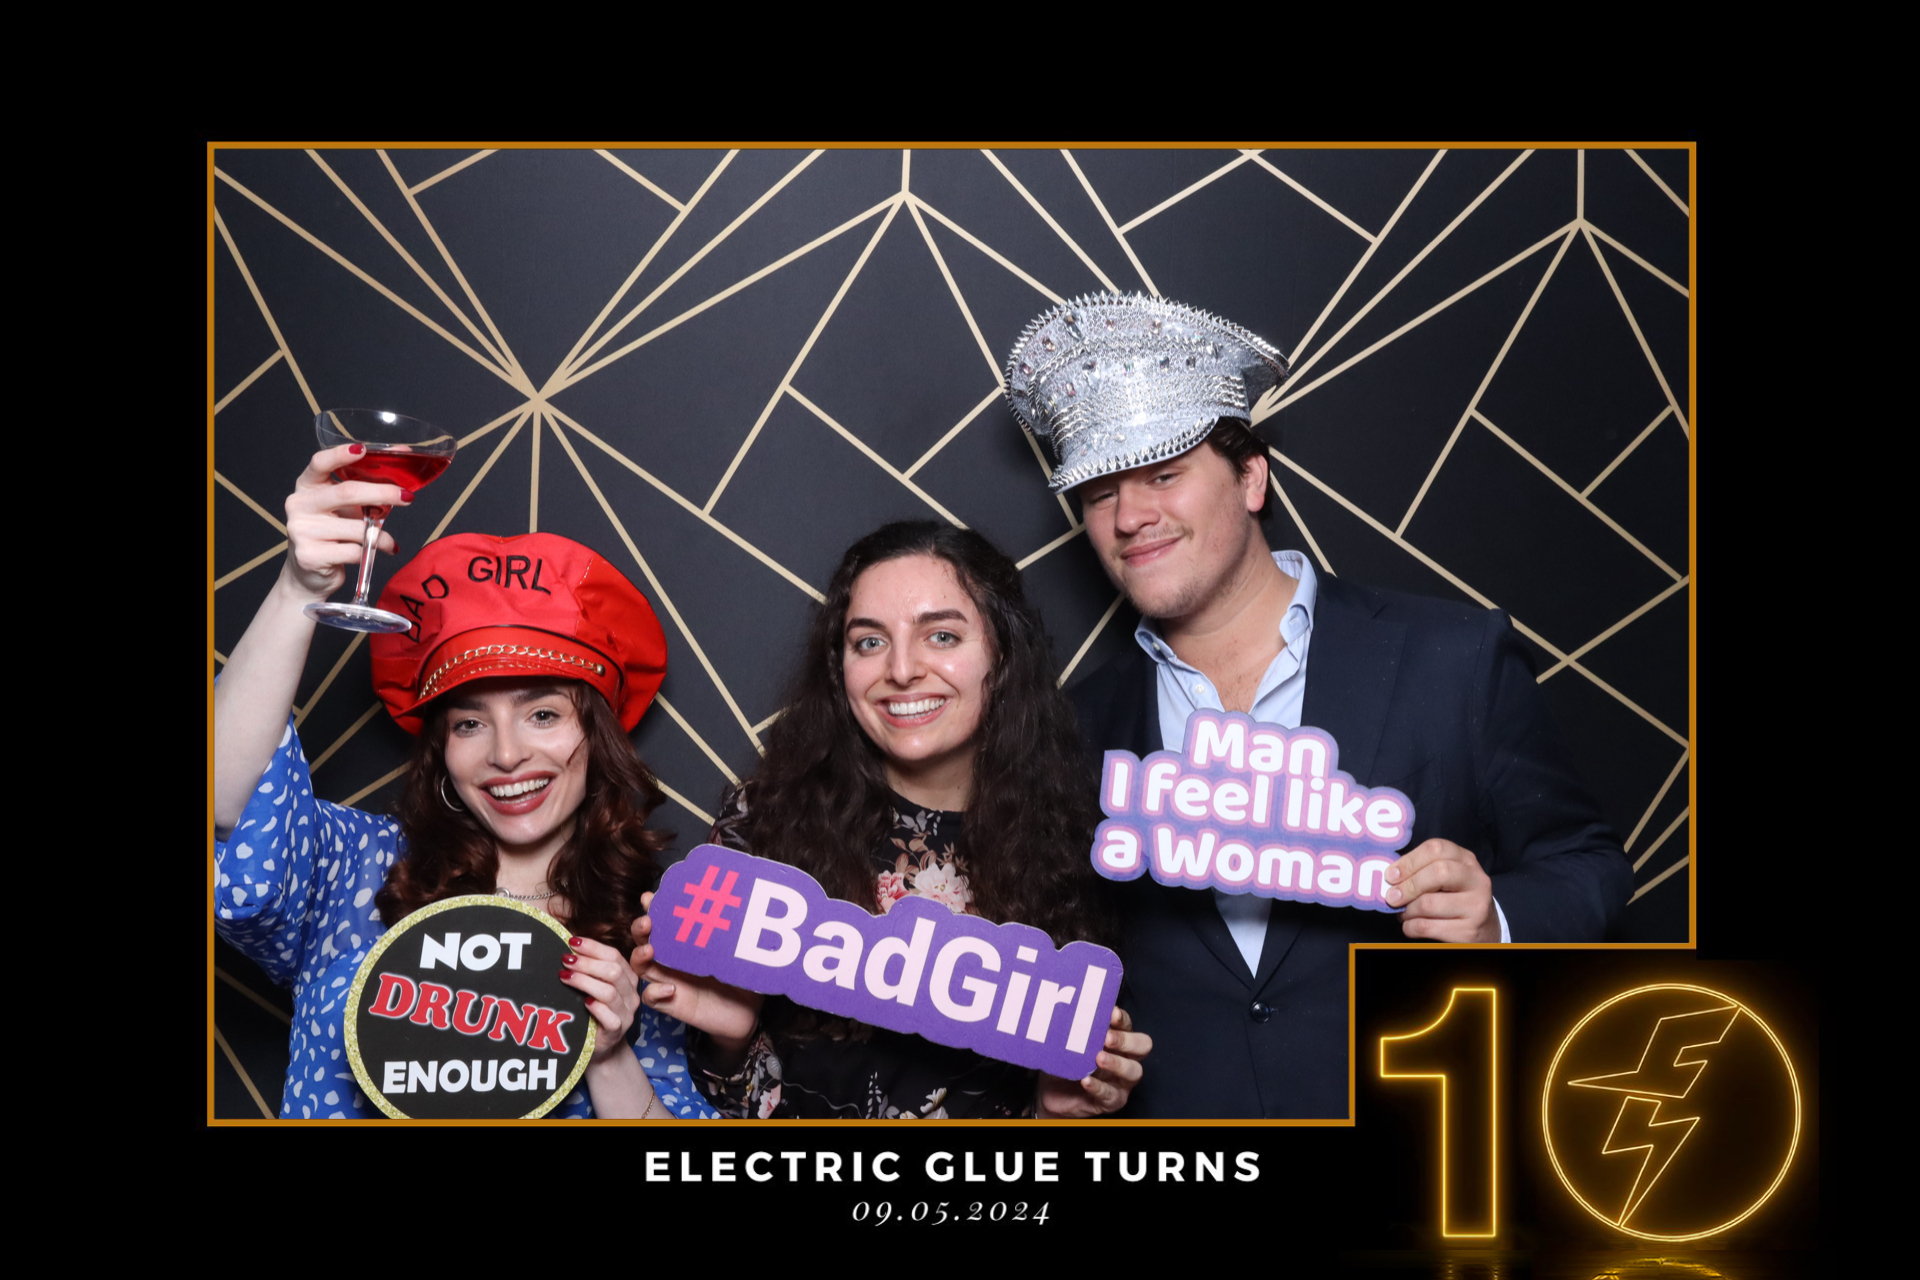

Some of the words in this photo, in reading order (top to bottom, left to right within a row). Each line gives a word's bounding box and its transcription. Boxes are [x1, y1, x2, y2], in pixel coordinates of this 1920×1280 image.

[467, 554, 552, 596] GIRL
[1193, 719, 1326, 778] Man
[1111, 762, 1129, 808] I
[1145, 762, 1270, 824] feel
[1286, 777, 1403, 838] like
[1102, 829, 1139, 869] a
[1156, 827, 1396, 901] Woman
[419, 932, 532, 972] NOT
[672, 864, 1108, 1055] #BadGirl
[369, 972, 575, 1054] DRUNK
[382, 1058, 558, 1094] ENOUGH
